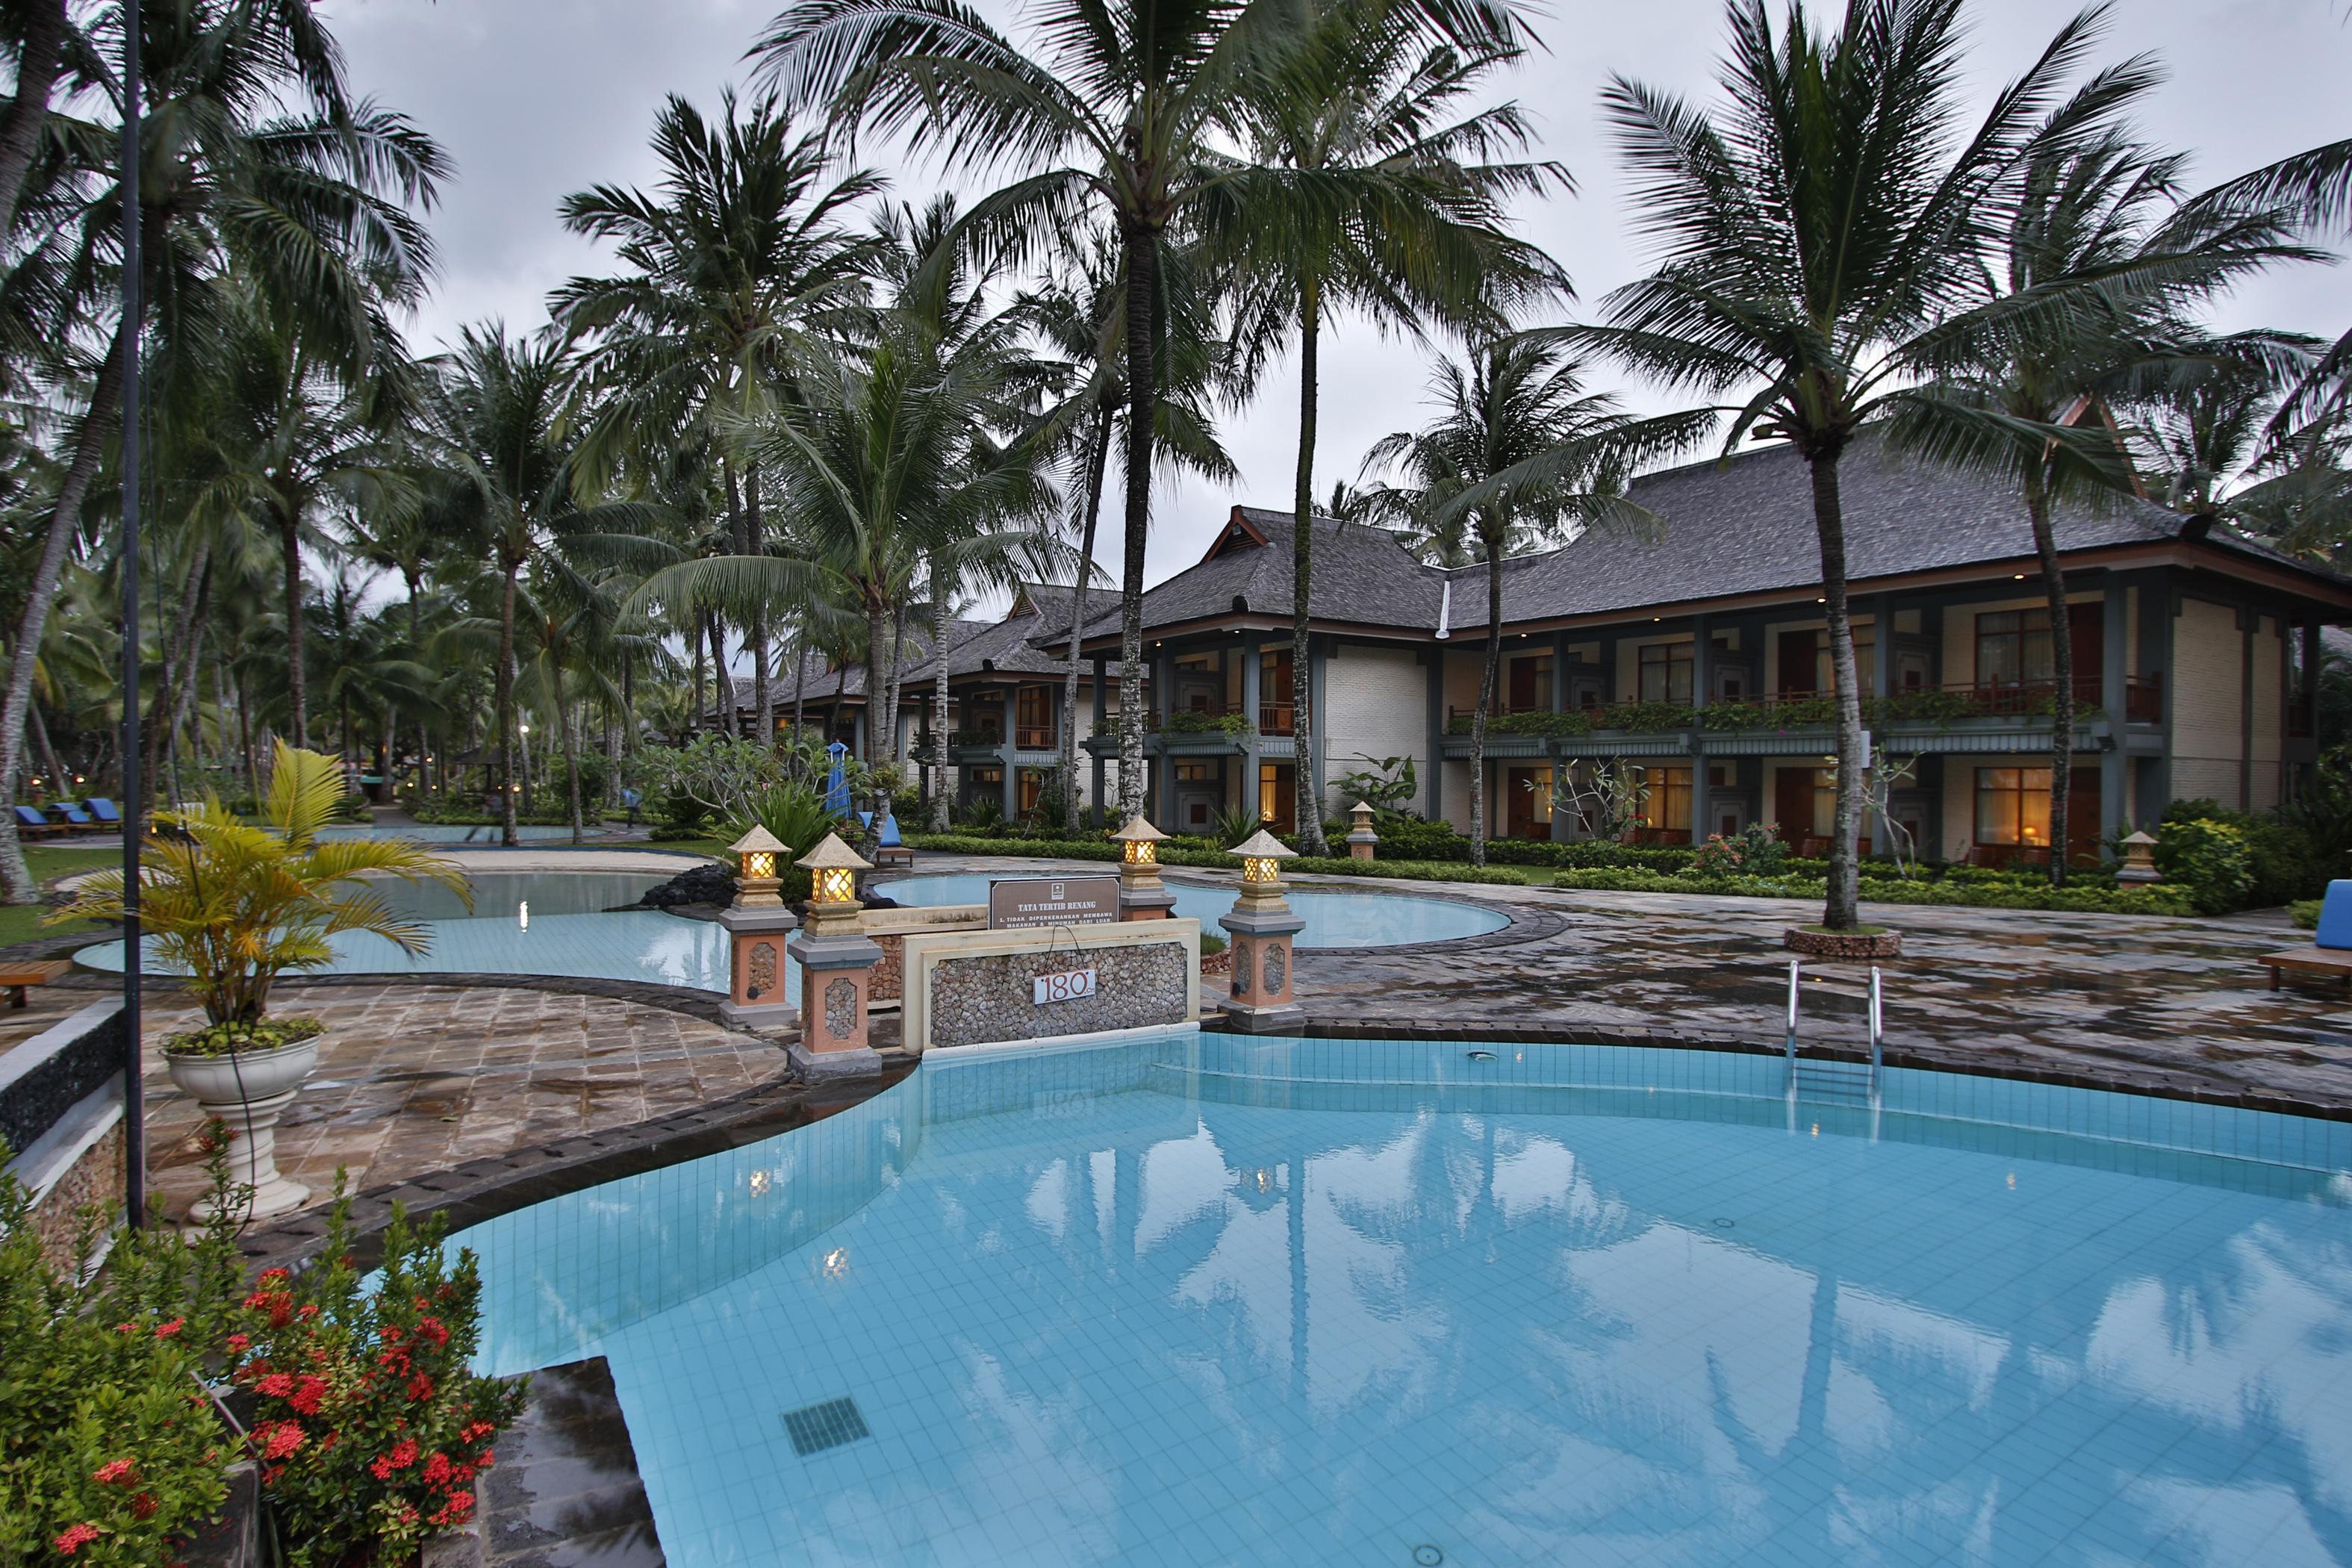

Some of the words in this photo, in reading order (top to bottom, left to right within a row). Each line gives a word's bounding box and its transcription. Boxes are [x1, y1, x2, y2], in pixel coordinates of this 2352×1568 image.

[1018, 903, 1037, 912] TATA
[1039, 903, 1065, 911] TERTIB
[1067, 901, 1096, 909] RENANG
